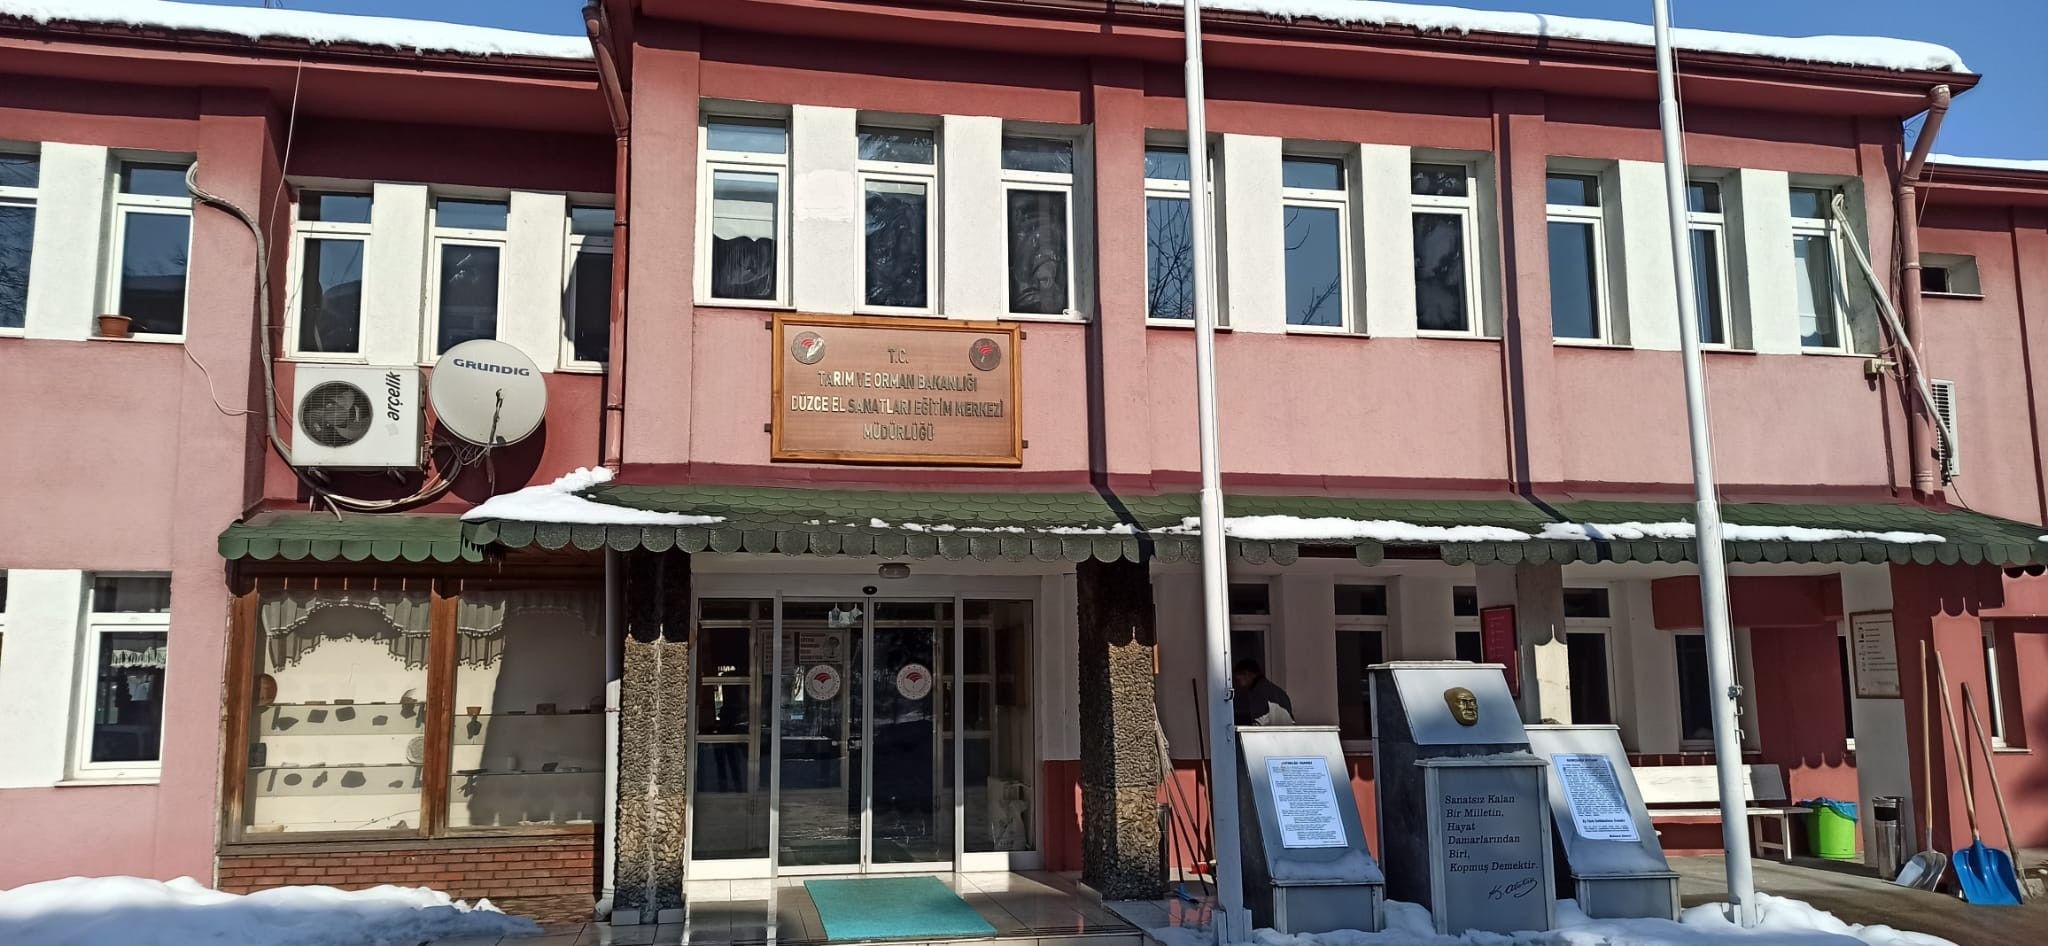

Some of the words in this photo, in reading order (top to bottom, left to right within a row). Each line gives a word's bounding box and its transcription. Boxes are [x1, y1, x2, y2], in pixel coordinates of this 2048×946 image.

[887, 347, 909, 364] T.C.
[818, 370, 854, 388] TARIM
[856, 372, 871, 389] VE
[873, 372, 915, 390] ORMAN
[917, 373, 978, 392] BAKANLIĞI
[385, 371, 404, 421] arçelik
[791, 392, 829, 412] DÜZCE
[831, 395, 846, 413] EL
[847, 397, 912, 416] SANATLARI
[914, 397, 953, 417] EĞİTİM
[954, 399, 1004, 418] MERKEZİ
[863, 421, 934, 441] MÜDÜRLÜĞÜ
[1445, 794, 1485, 805] Sanatsız
[1488, 794, 1515, 804] Kalan
[1446, 808, 1461, 818] Bir
[1447, 822, 1475, 834] Hayat
[1448, 834, 1521, 845] Damarlarından
[1450, 862, 1489, 874] Kopmuş
[1491, 860, 1539, 871] Demektir.
